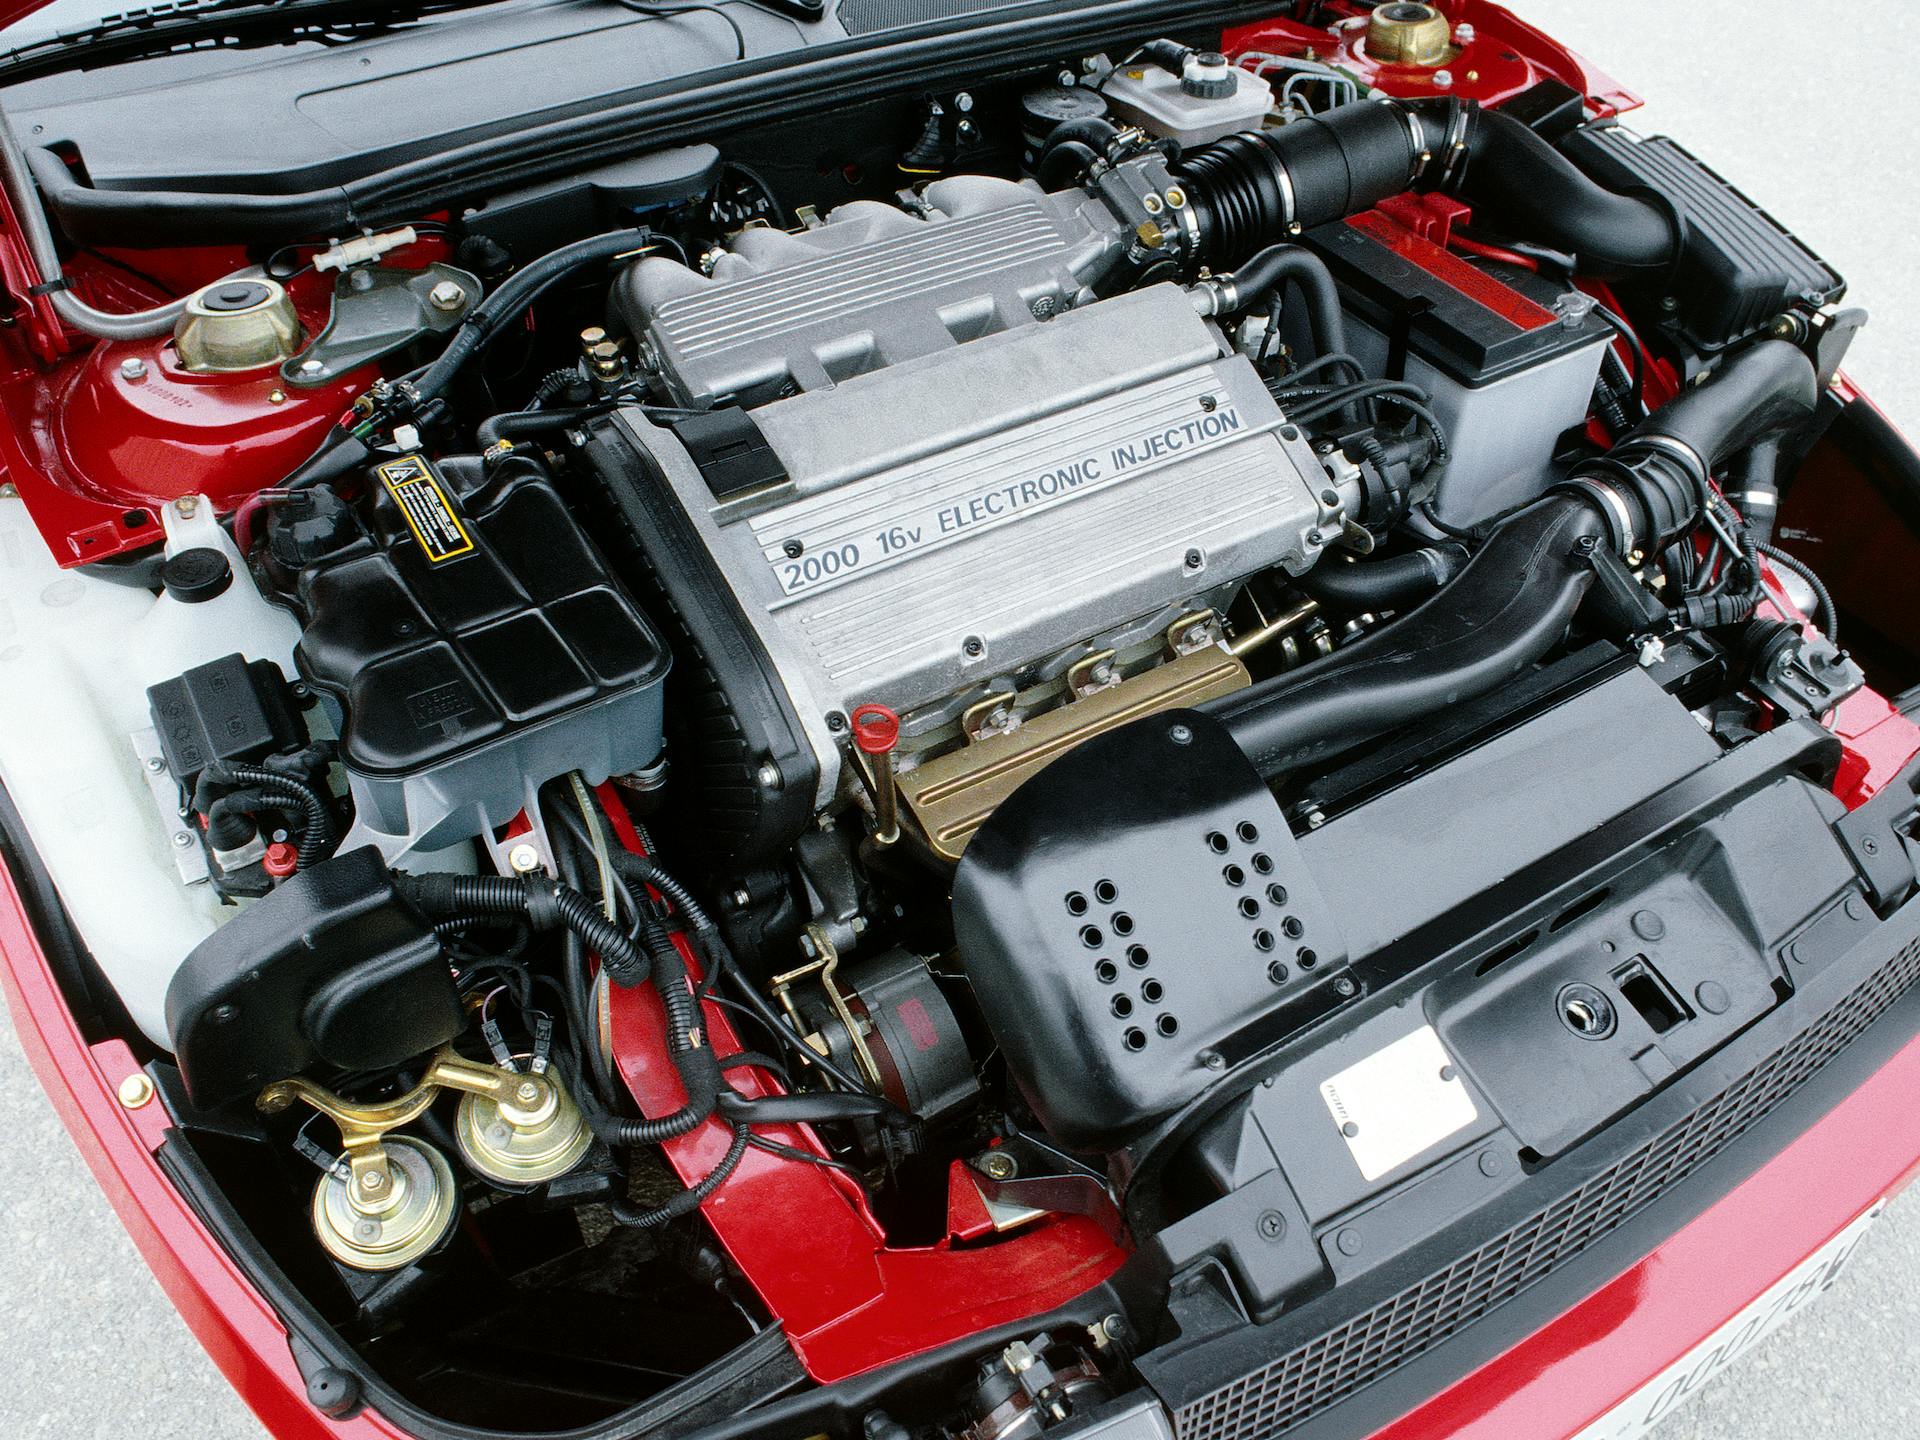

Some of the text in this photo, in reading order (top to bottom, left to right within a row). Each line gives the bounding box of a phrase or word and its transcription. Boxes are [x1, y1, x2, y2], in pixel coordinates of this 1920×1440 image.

[784, 409, 1240, 590] 2000 16v ELECTRONIC INJECTION
